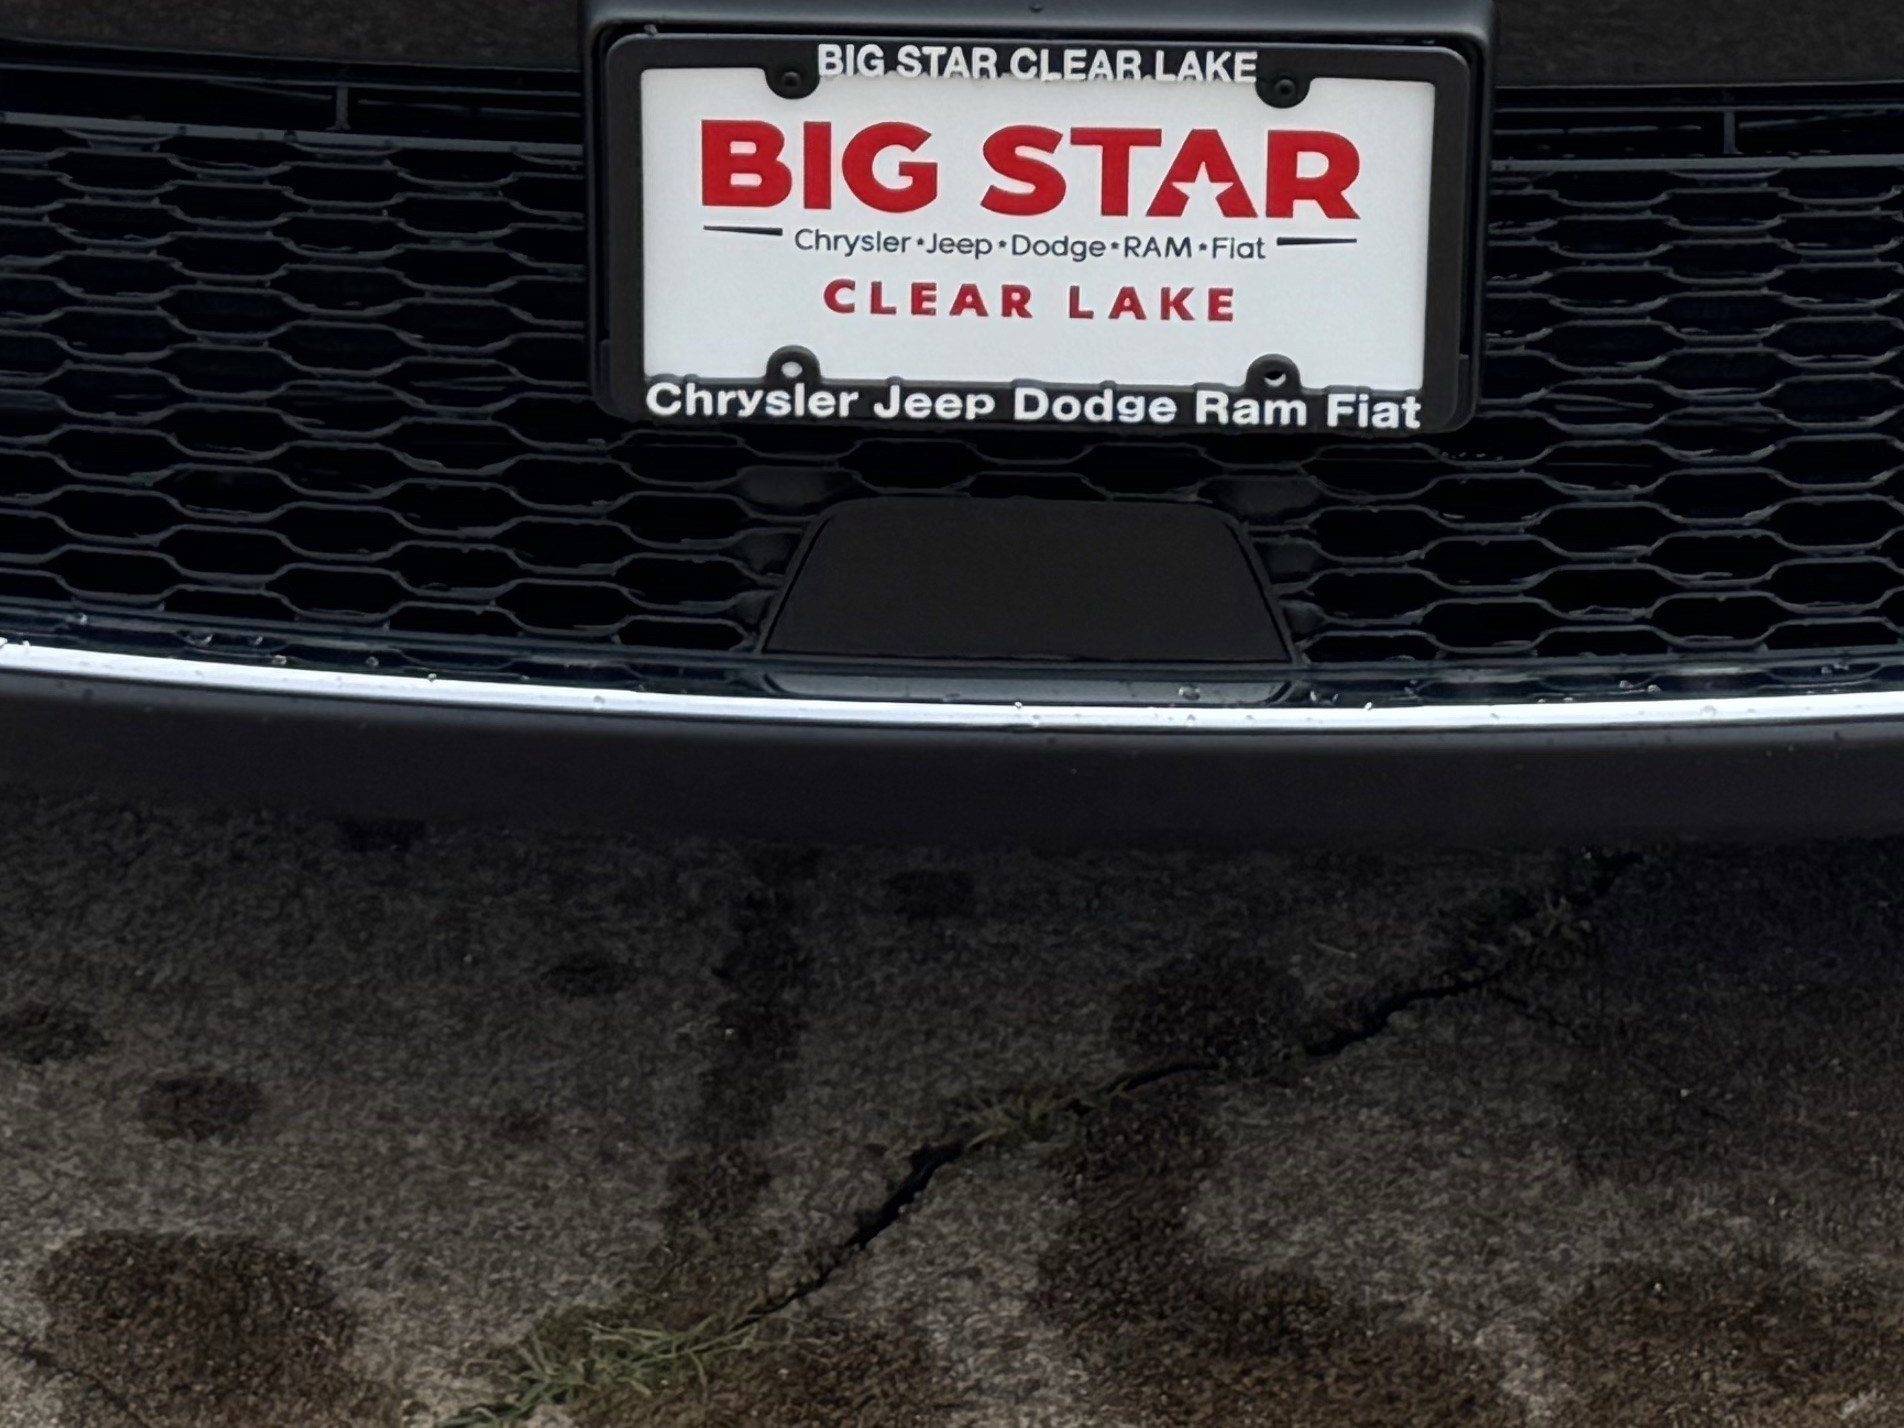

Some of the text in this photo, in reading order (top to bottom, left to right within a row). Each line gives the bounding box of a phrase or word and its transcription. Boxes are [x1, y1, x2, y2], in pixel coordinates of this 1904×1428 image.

[817, 43, 1258, 84] BIG STAR CLEAR LAKE
[701, 119, 1360, 220] BIG STAR
[794, 227, 912, 258] Chrysler
[925, 233, 993, 258] Jeep
[1011, 234, 1107, 263] Dodge
[1123, 236, 1193, 259] RAM
[823, 278, 1234, 323] CLEAR LAKE
[645, 381, 1422, 431] Chrysler Jeep Dodge Ram Fiat
